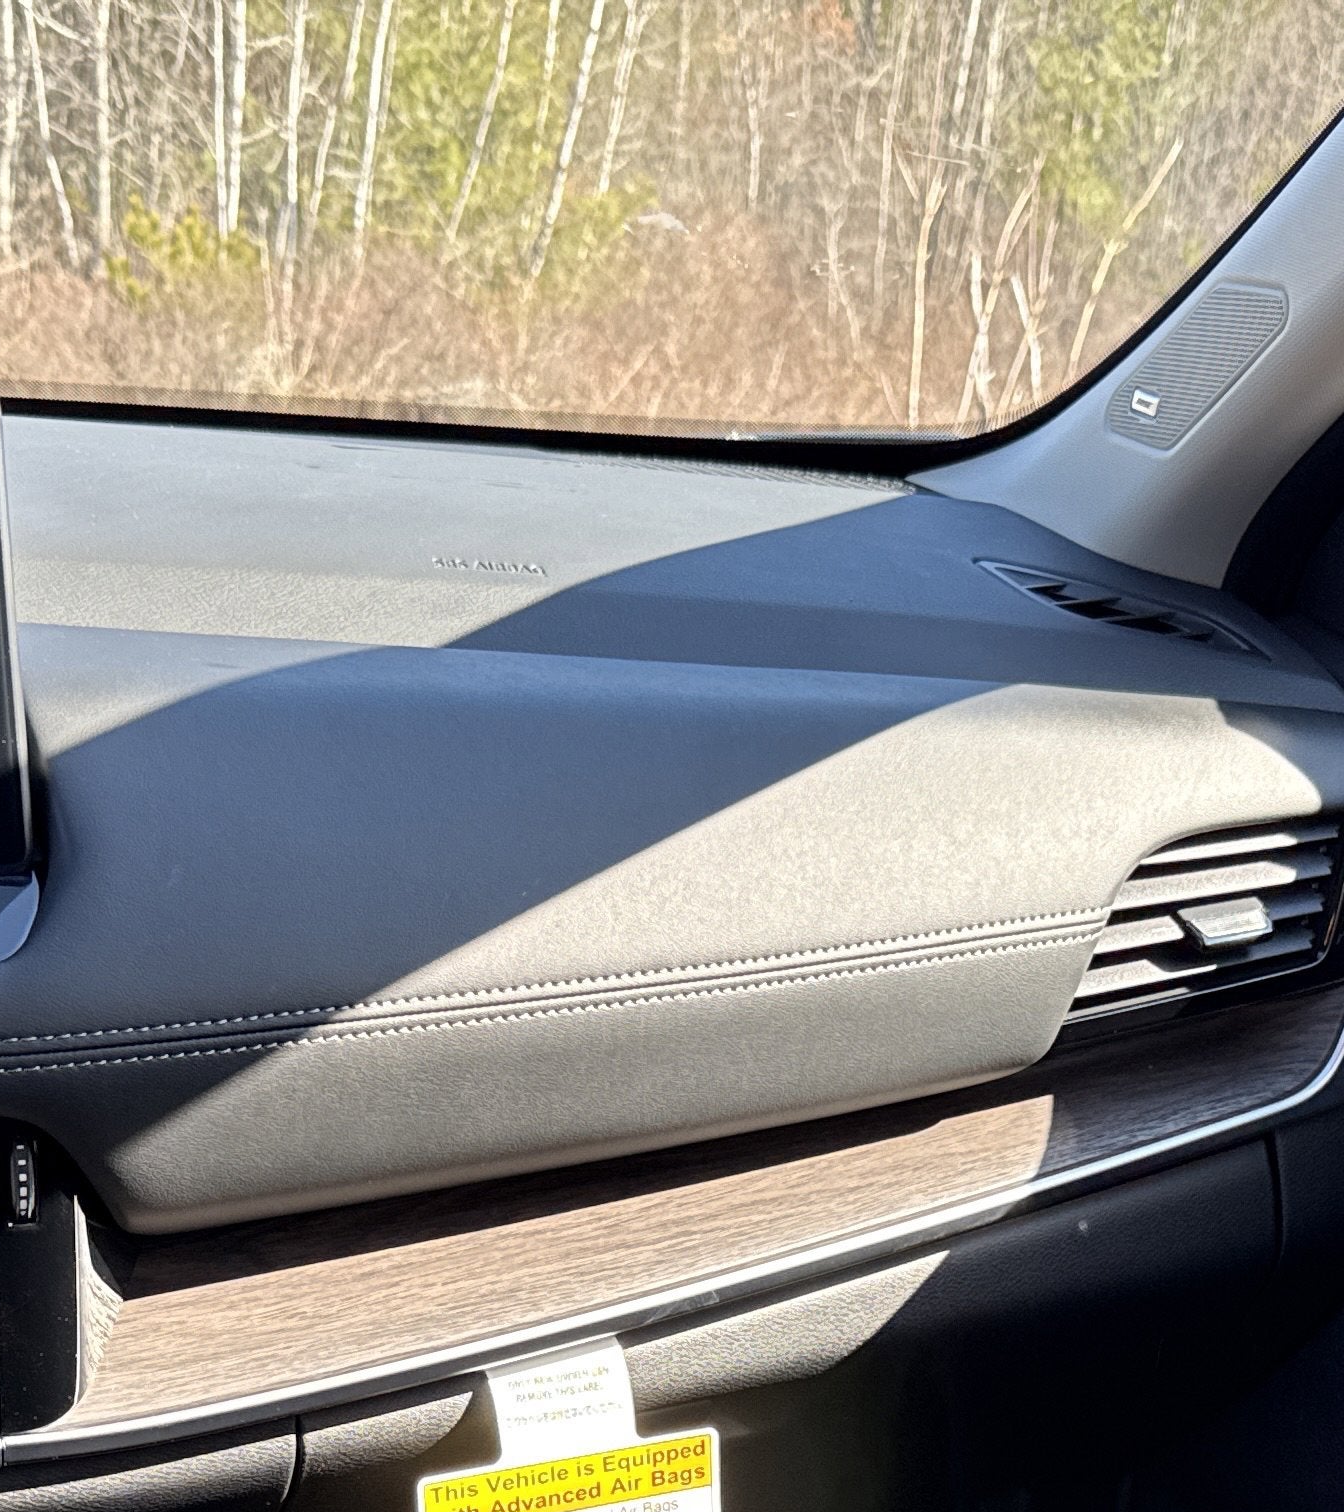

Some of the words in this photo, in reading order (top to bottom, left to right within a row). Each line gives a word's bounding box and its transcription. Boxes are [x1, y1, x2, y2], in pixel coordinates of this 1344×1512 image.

[429, 1479, 478, 1504] This
[486, 1463, 568, 1494] Vehicle
[576, 1459, 594, 1477] is
[602, 1439, 705, 1476] Equipped
[610, 1473, 642, 1494] Air
[651, 1462, 705, 1491] Bags
